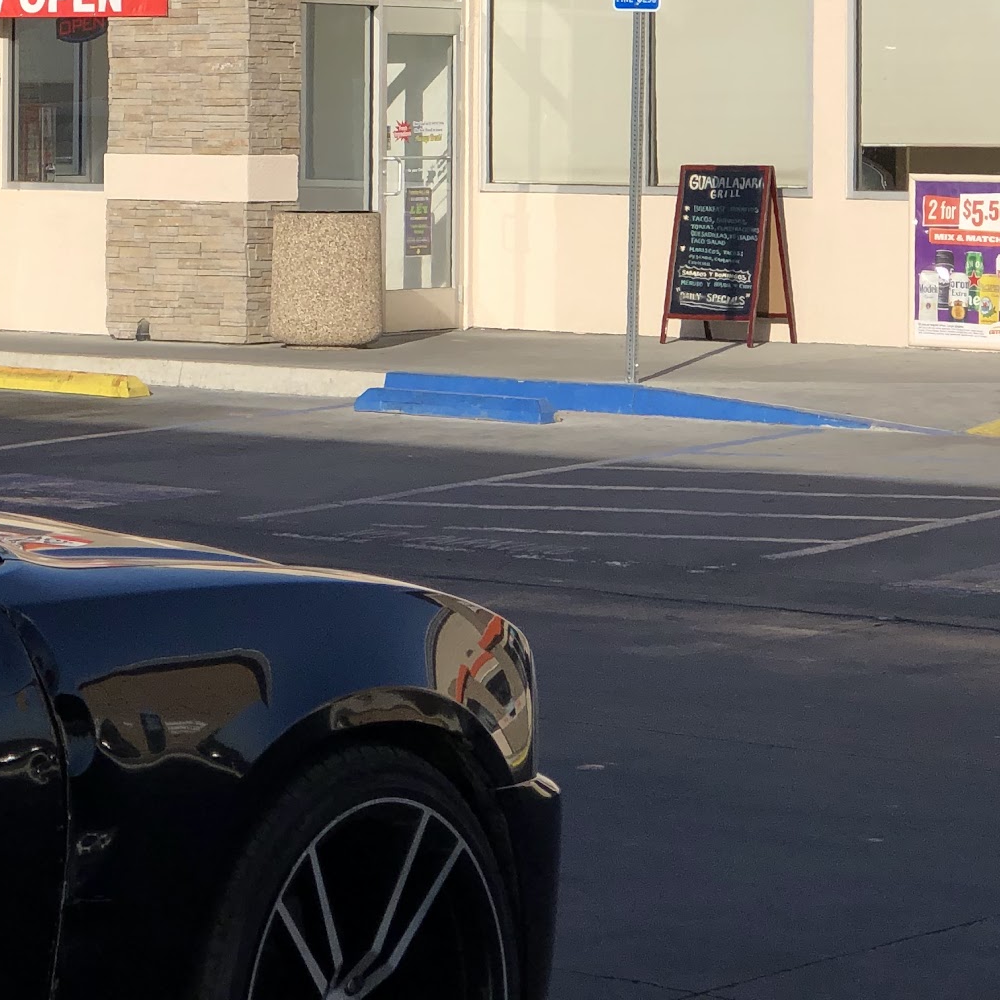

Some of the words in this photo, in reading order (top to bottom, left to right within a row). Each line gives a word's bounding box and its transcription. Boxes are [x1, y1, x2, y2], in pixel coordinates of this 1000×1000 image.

[59, 18, 105, 36] OPEN
[689, 174, 764, 190] GUADALAJARA
[710, 189, 741, 200] GRILL
[928, 199, 938, 220] 2
[940, 200, 957, 220] for
[934, 233, 955, 241] MIX
[956, 234, 965, 242] &
